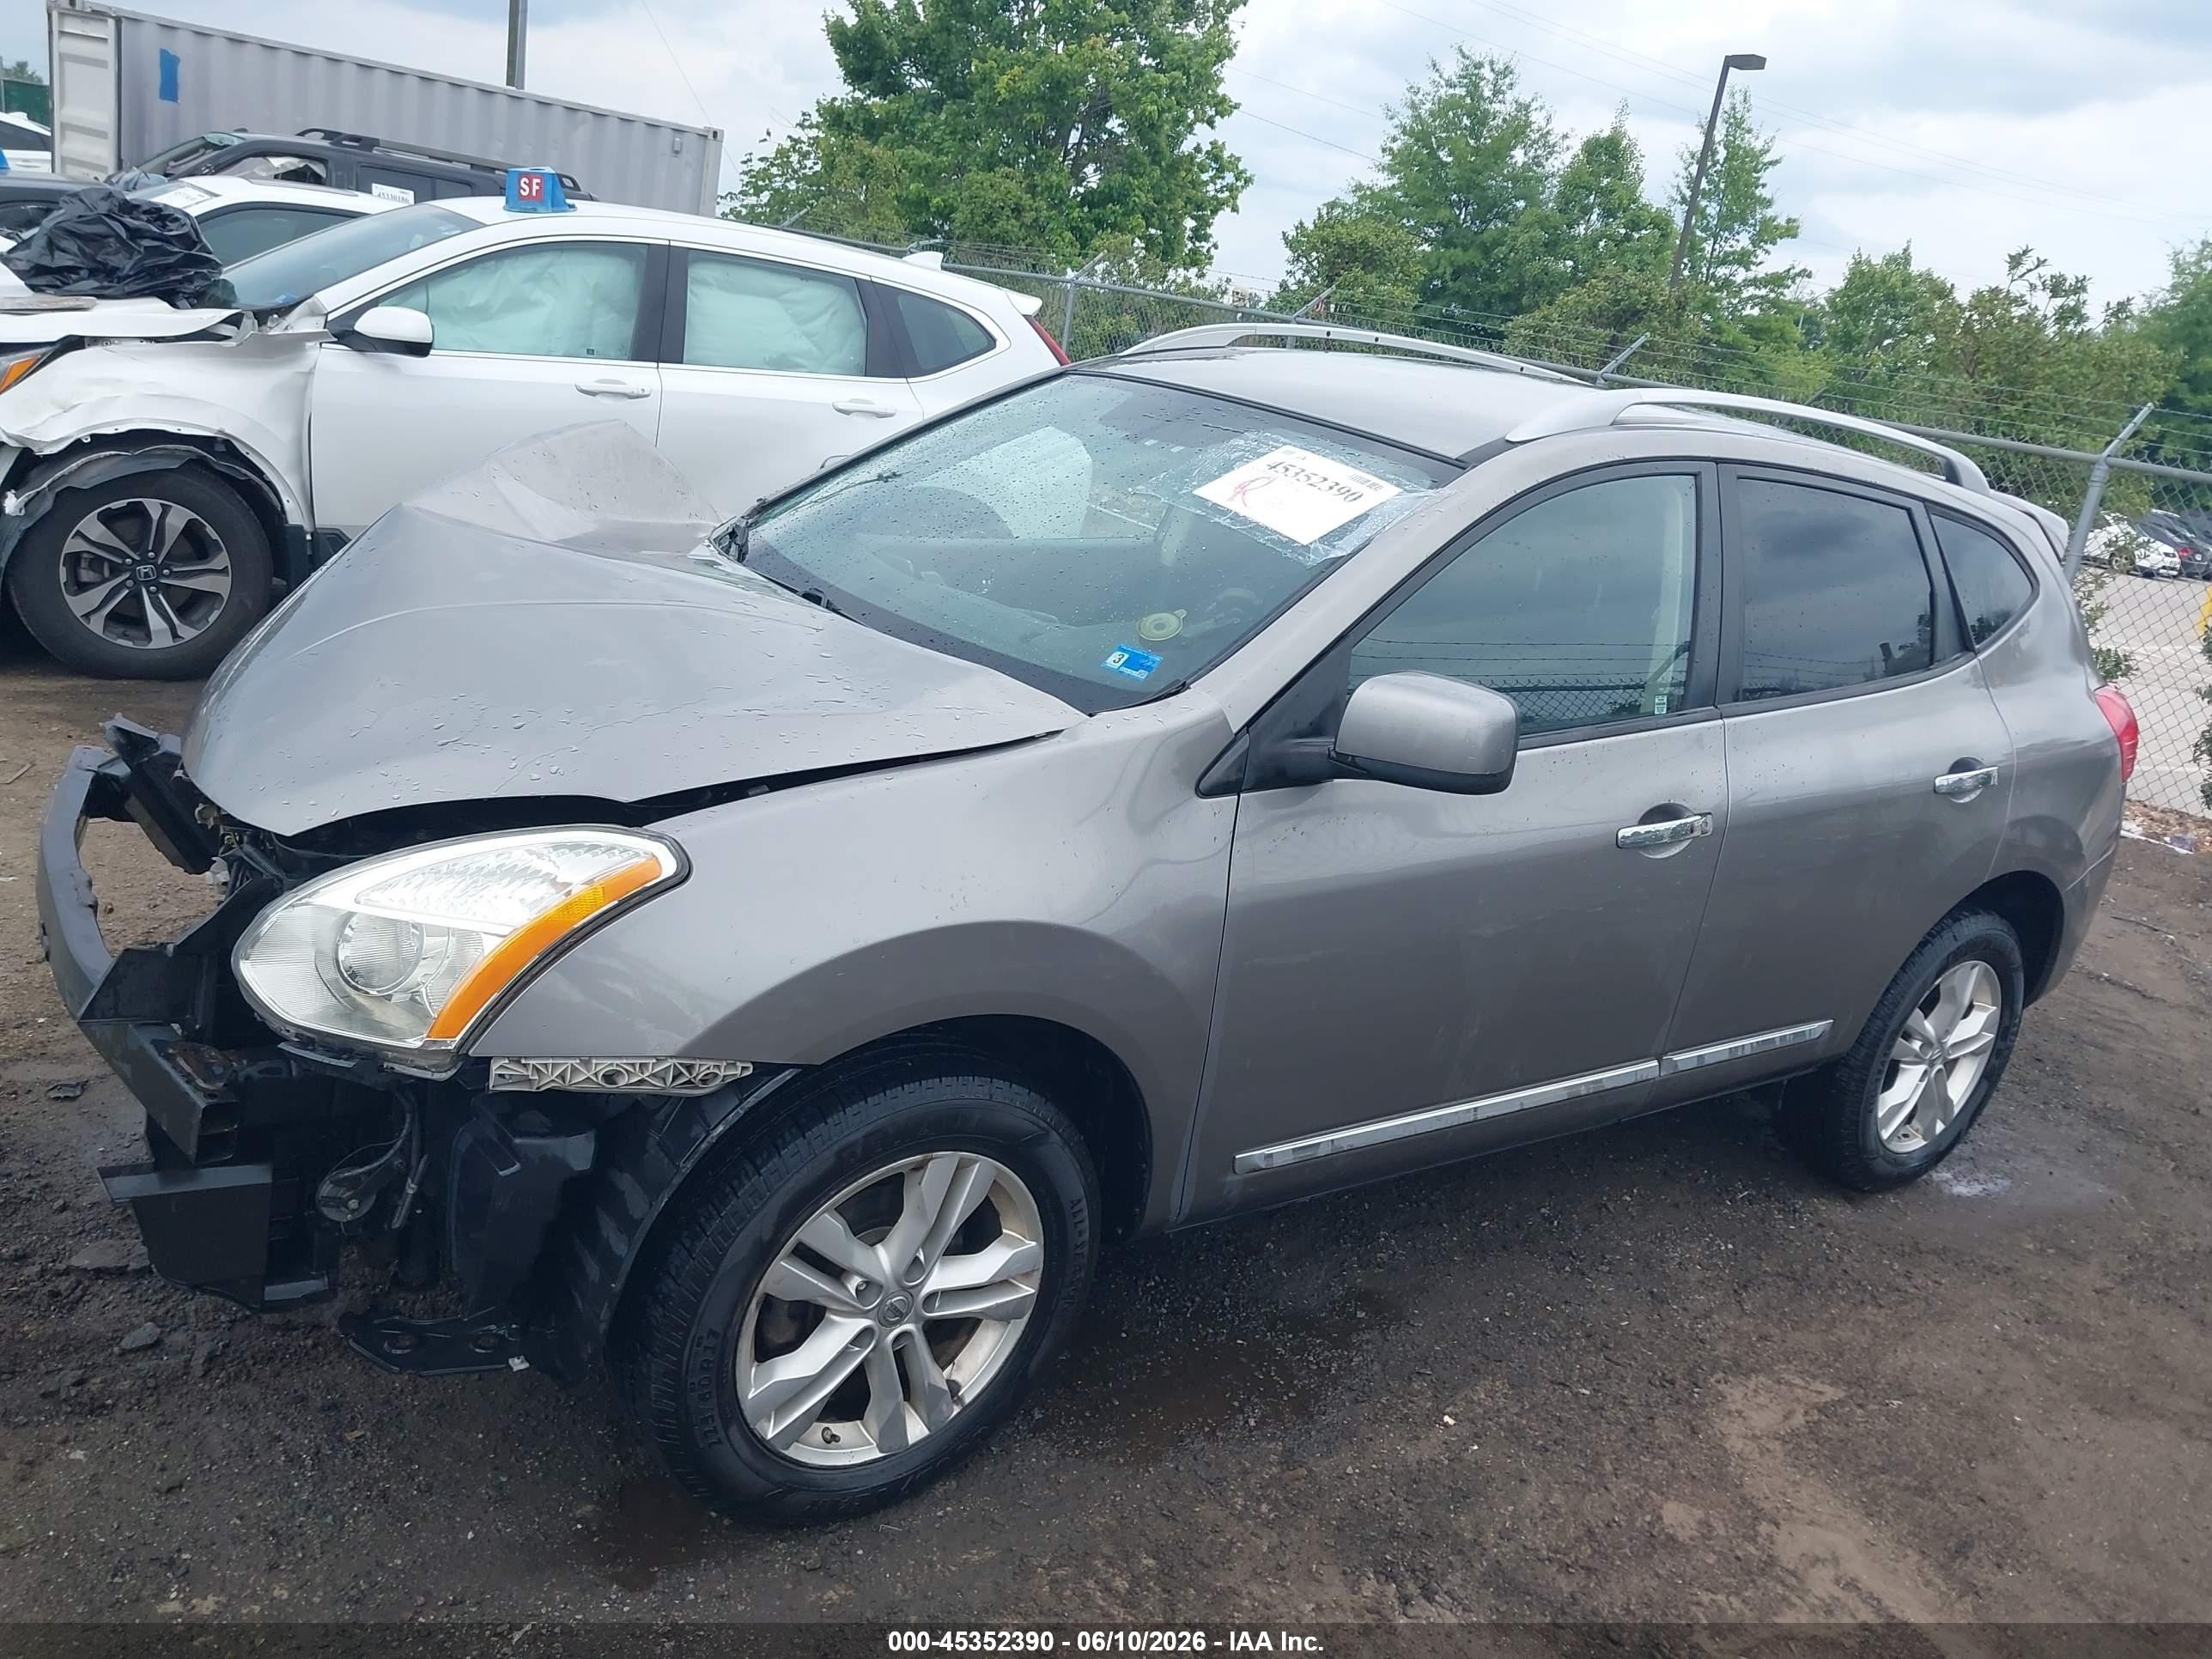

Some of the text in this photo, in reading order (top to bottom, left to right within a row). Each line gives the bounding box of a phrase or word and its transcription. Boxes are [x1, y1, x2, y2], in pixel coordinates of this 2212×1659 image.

[520, 177, 542, 198] SF
[1267, 461, 1364, 502] 45352390
[1113, 653, 1125, 664] 3
